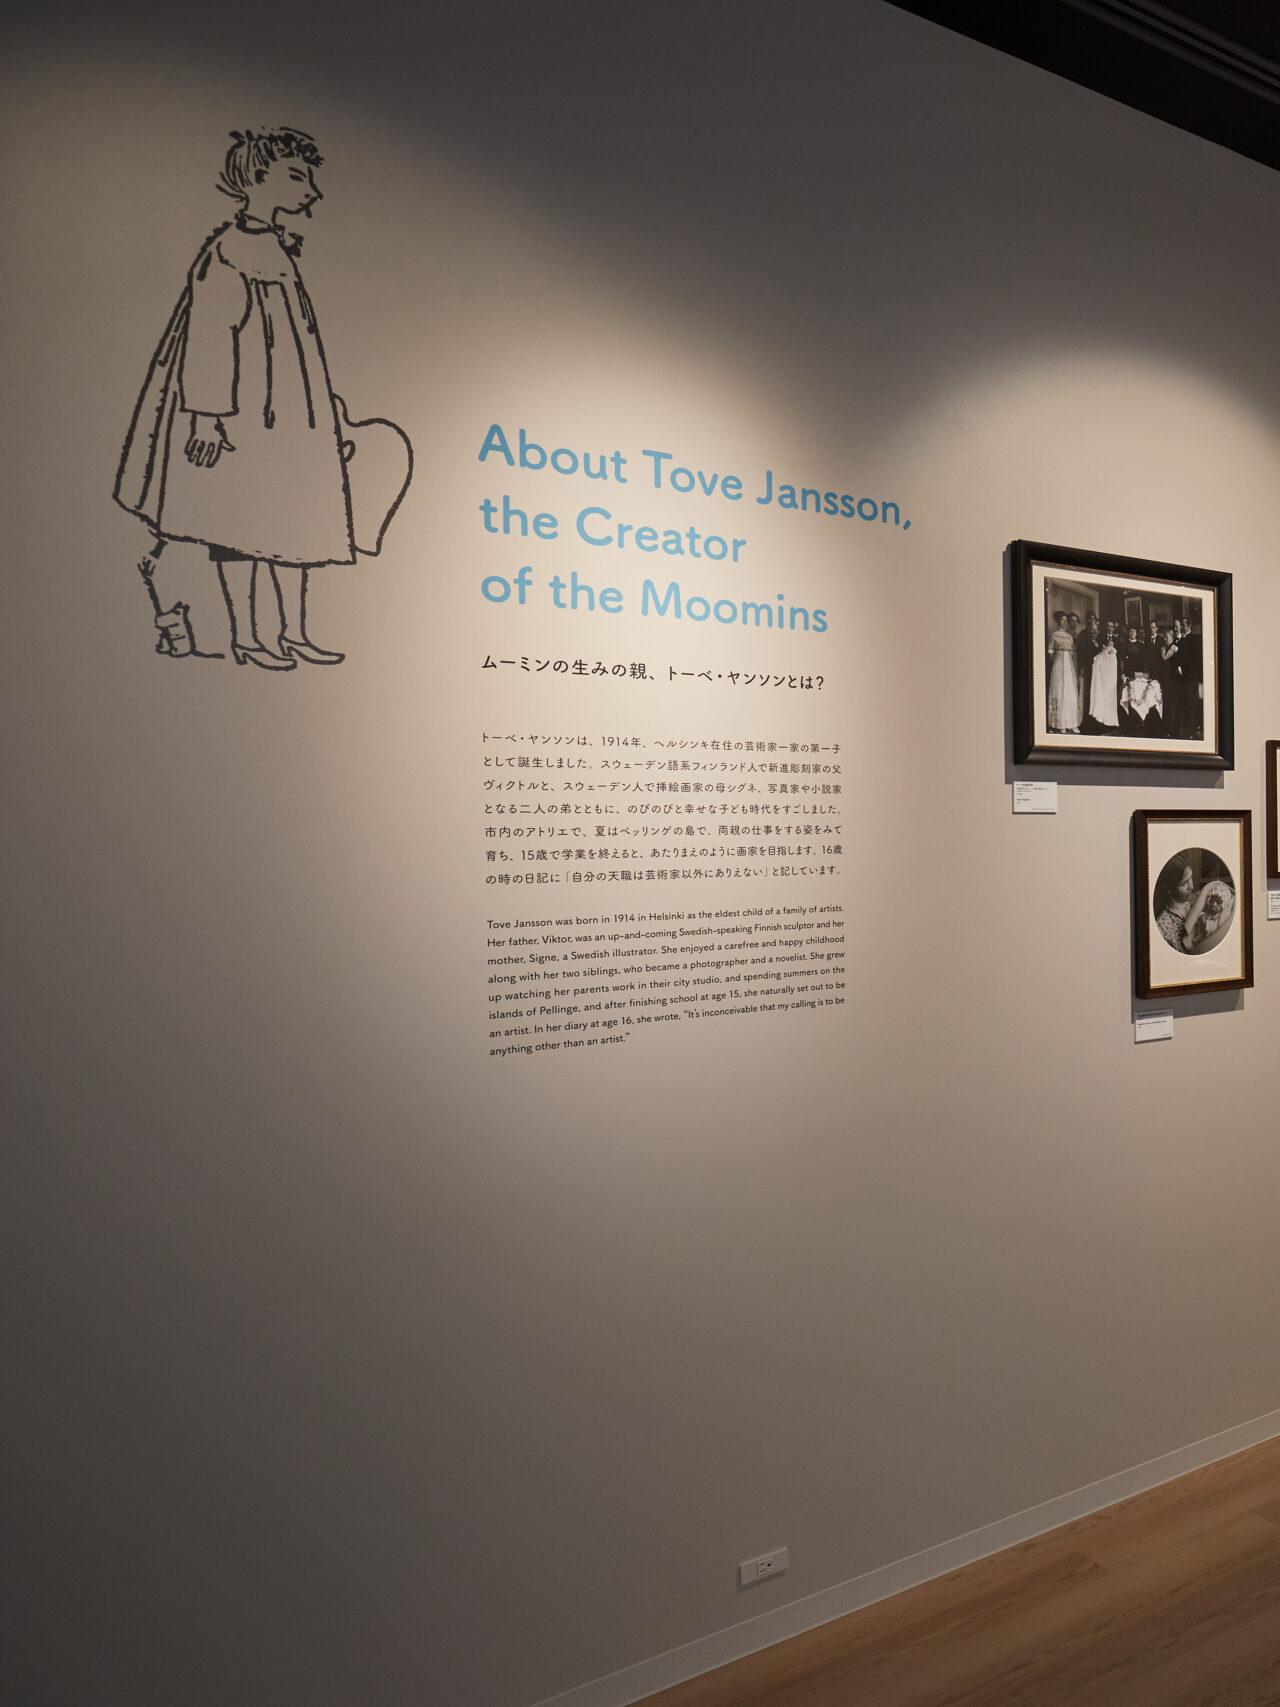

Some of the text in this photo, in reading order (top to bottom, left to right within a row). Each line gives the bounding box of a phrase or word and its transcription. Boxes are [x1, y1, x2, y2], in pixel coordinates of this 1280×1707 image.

[478, 424, 912, 531] About Tove Jansson,
[479, 495, 746, 562] the Creator
[481, 566, 829, 633] of the Moomins
[487, 920, 511, 929] Tove
[514, 919, 552, 928] Jansson
[576, 916, 598, 925] born
[615, 914, 635, 923] 1914
[638, 914, 646, 922] in
[649, 912, 684, 921] Helsinki
[699, 910, 712, 919] the
[715, 909, 740, 918] eldest
[742, 908, 763, 917] child
[765, 907, 774, 916] of
[783, 906, 807, 916] family
[809, 905, 817, 913] of
[487, 938, 506, 947] Her
[608, 930, 678, 942] up-and-coming
[679, 925, 752, 936] Swedish-speaking
[754, 923, 782, 932] Finnish
[784, 921, 814, 932] sculptor
[816, 920, 831, 928] and
[832, 920, 845, 928] her
[571, 949, 610, 960] Swedish
[661, 946, 678, 954] She
[680, 943, 714, 955] enjoyed
[724, 940, 759, 950] carefree
[761, 939, 776, 948] and
[779, 938, 804, 948] happy
[805, 934, 844, 945] childhood
[488, 974, 517, 985] along
[519, 972, 540, 981] with
[543, 970, 560, 979] her
[623, 964, 643, 974] who
[645, 964, 680, 972] became
[690, 957, 748, 971] photographer
[751, 955, 766, 964] and
[809, 952, 825, 960] She
[826, 952, 845, 961] grew
[488, 994, 502, 1004] up
[505, 989, 552, 1000] watching
[554, 988, 570, 996] her
[573, 985, 610, 997] parents
[612, 982, 635, 992] work
[638, 982, 647, 990] in
[649, 980, 671, 988] their
[673, 979, 690, 988] city
[725, 973, 741, 982] and
[743, 971, 782, 982] spending
[783, 969, 819, 978] summers
[832, 966, 845, 974] the
[489, 1008, 523, 1020] islands
[525, 1006, 536, 1017] of
[584, 1002, 602, 1011] and
[604, 1000, 626, 1010] after
[629, 997, 668, 1007] finishing
[669, 993, 698, 1004] school
[700, 993, 709, 1001] at
[711, 993, 726, 1002] age
[744, 988, 758, 997] she
[760, 985, 795, 996] naturally
[836, 981, 846, 989] be
[534, 1024, 543, 1034] In
[546, 1024, 561, 1032] her
[564, 1021, 588, 1032] diary
[590, 1020, 600, 1028] at
[602, 1020, 618, 1029] age
[637, 1015, 652, 1024] she
[702, 1004, 758, 1017] inconceivable
[760, 1003, 776, 1012] that
[778, 1003, 789, 1012] my
[791, 1000, 816, 1009] calling
[817, 998, 824, 1006] is
[825, 998, 833, 1006] to
[835, 996, 845, 1004] be
[489, 1044, 533, 1057] anything
[535, 1041, 561, 1051] other
[563, 1039, 584, 1048] than
[586, 1038, 598, 1046] an
